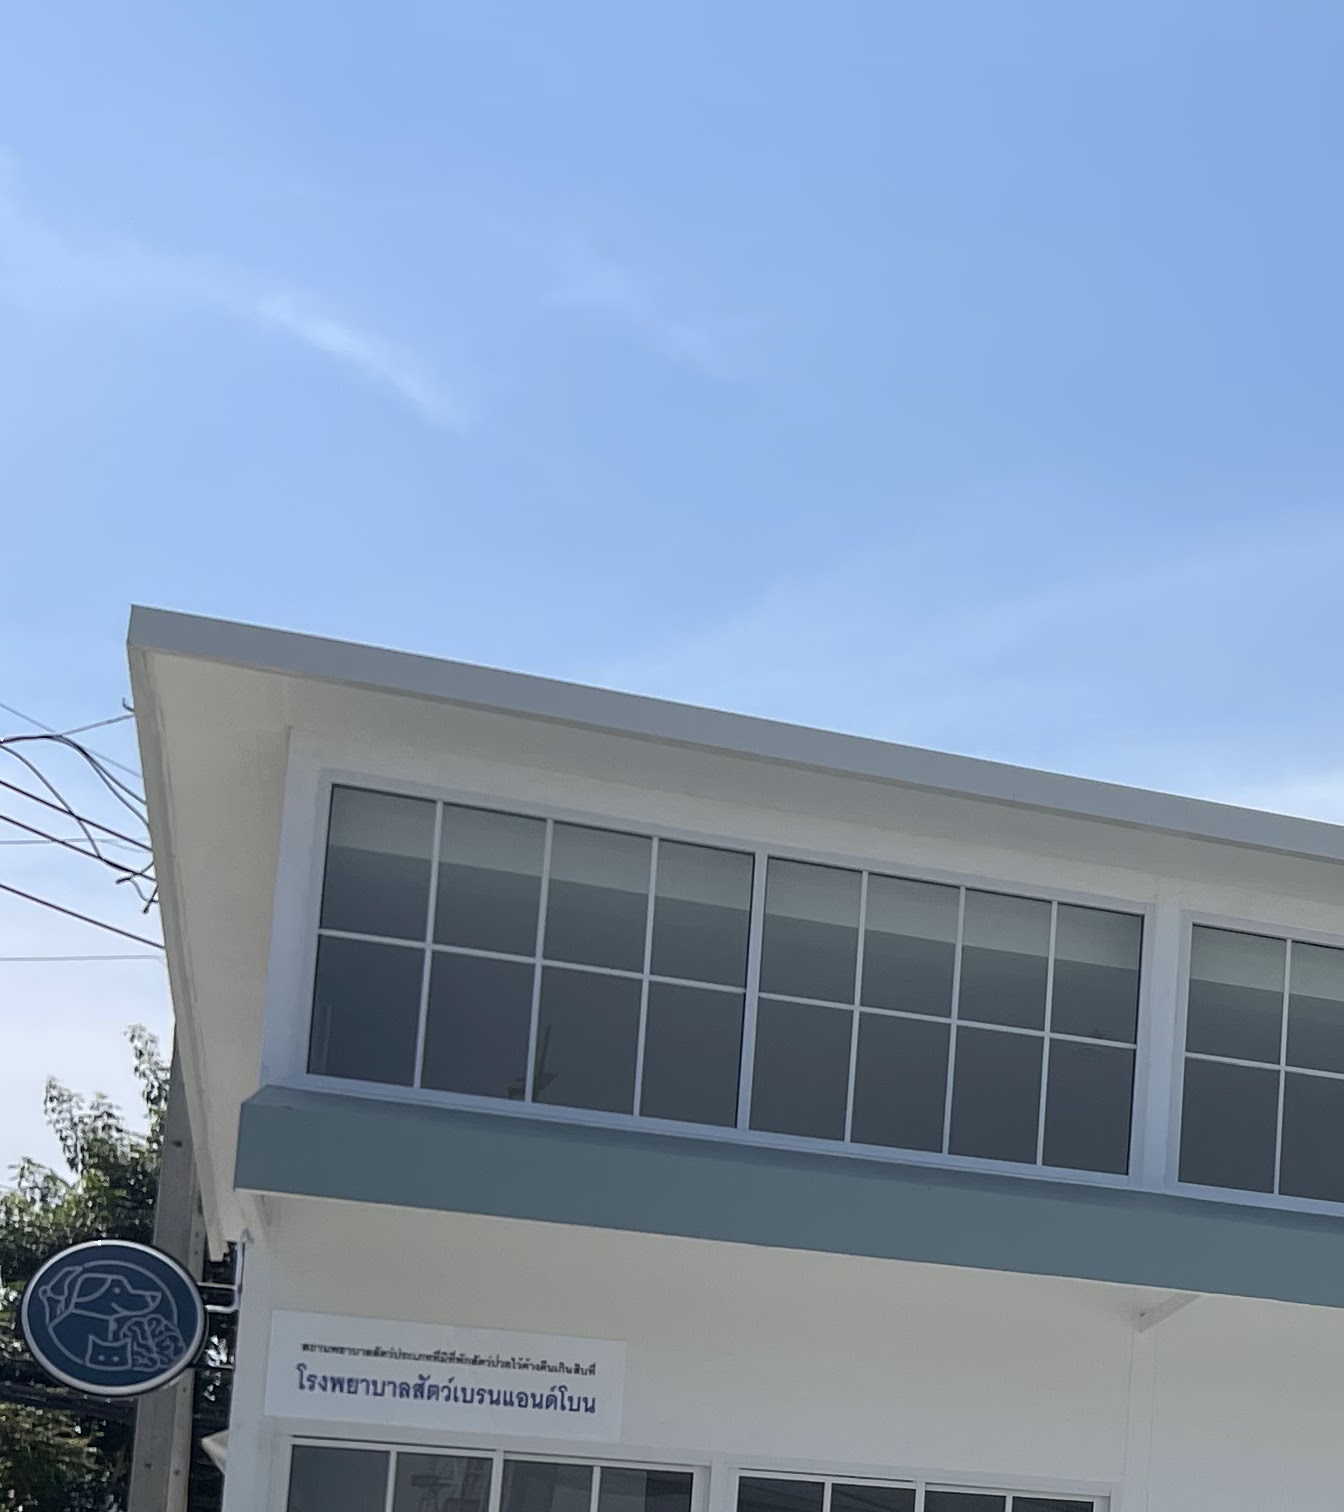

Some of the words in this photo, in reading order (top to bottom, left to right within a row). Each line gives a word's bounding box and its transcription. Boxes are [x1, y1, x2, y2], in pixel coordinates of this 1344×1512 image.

[296, 1361, 597, 1414] โรงพยาบาลสัตว์เบรนแอนด์โบน
